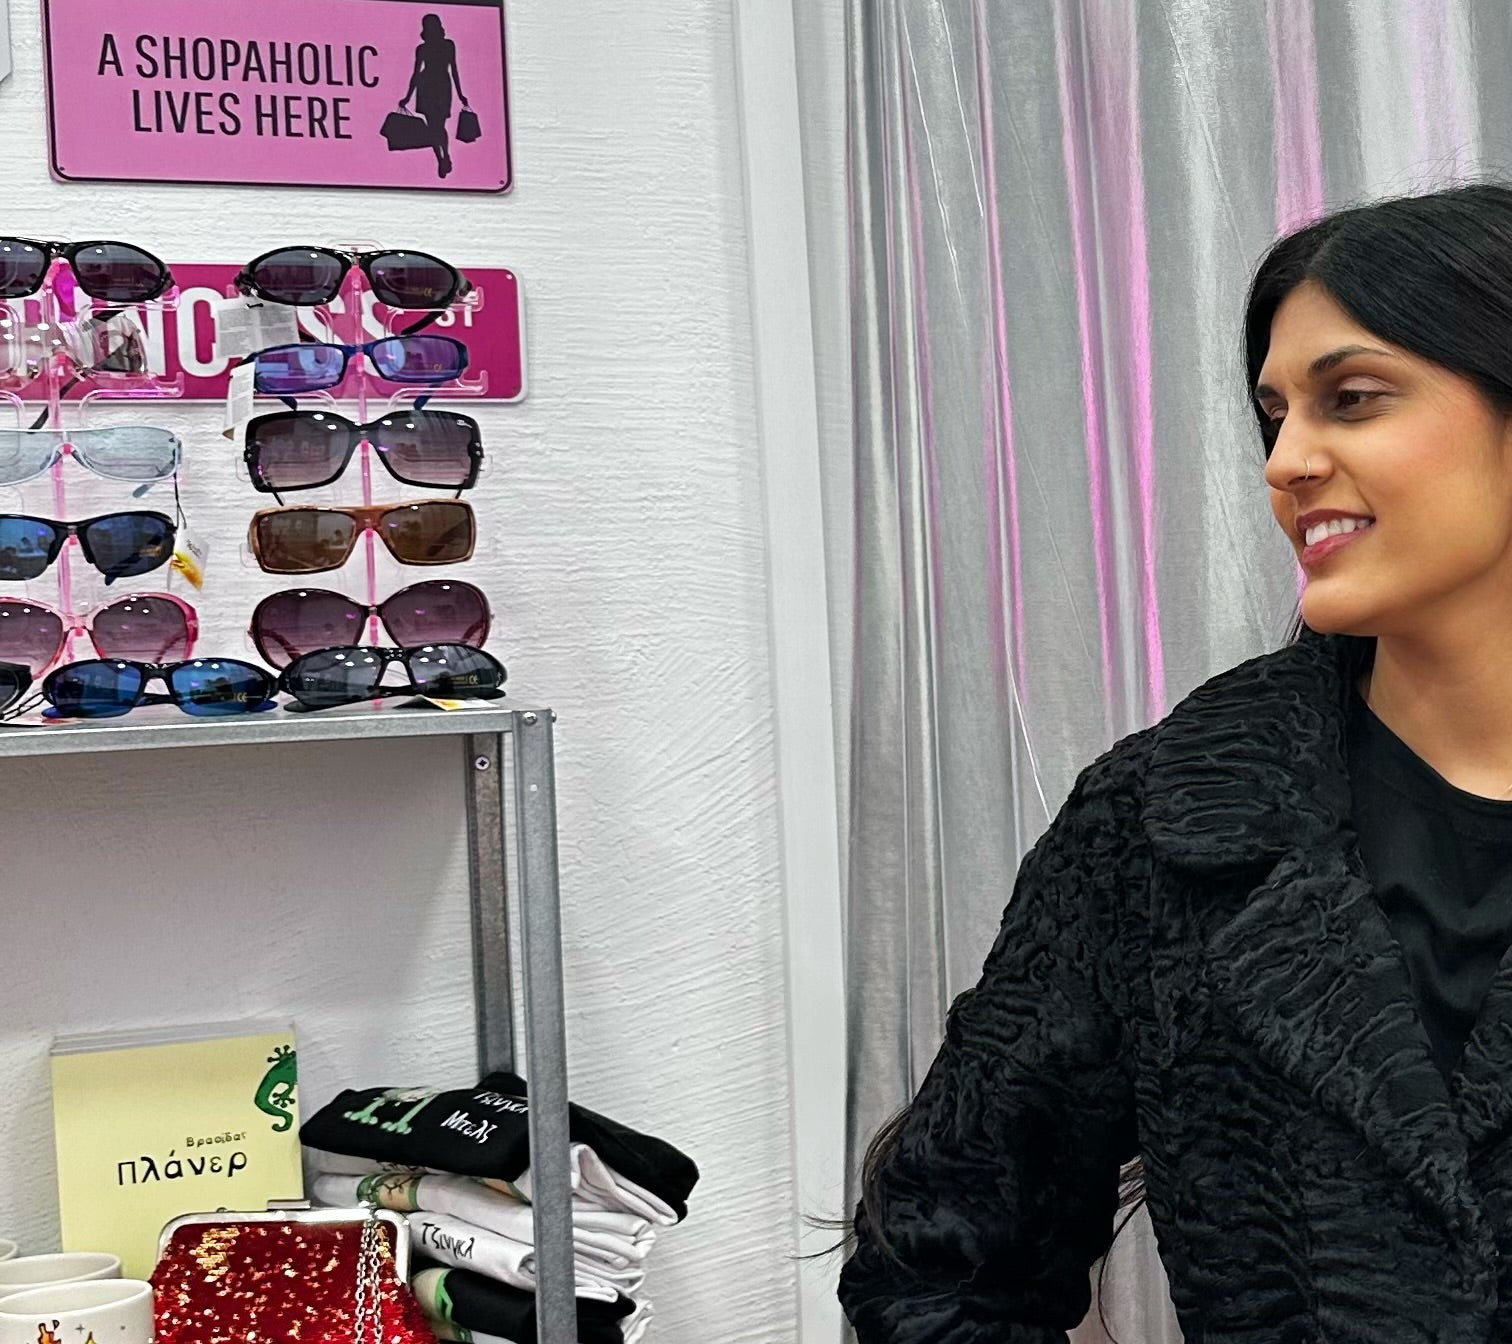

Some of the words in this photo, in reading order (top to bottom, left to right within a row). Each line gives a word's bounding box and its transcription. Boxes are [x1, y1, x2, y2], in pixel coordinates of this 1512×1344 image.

[97, 33, 124, 76] A
[135, 34, 380, 88] SHOPAHOLIC
[132, 89, 242, 136] LIVES
[254, 95, 353, 139] HERE
